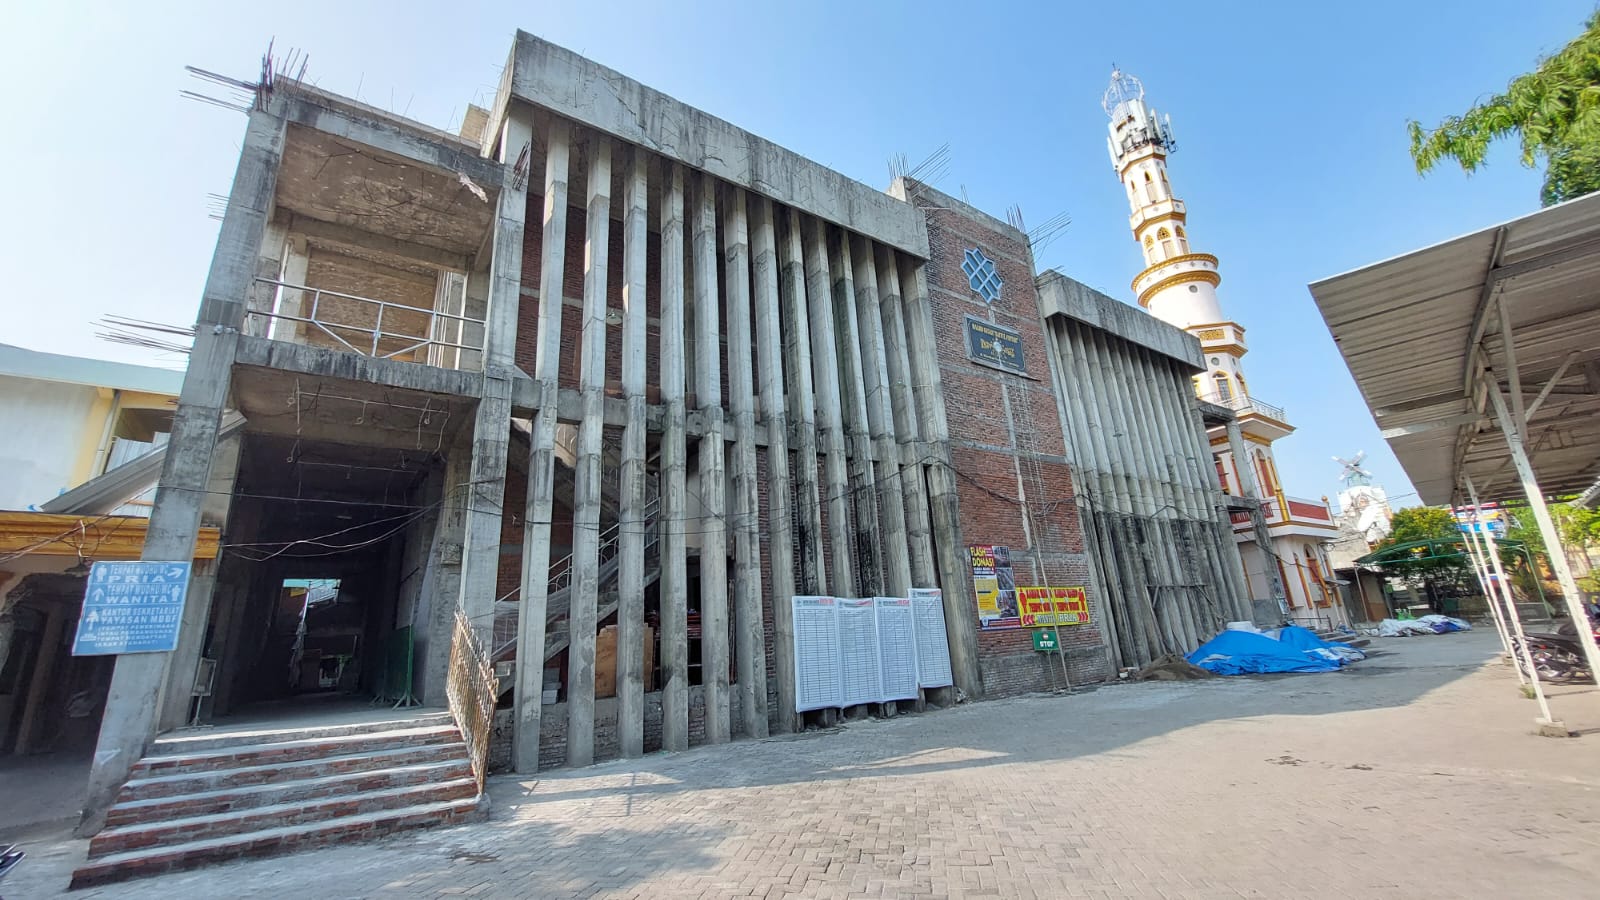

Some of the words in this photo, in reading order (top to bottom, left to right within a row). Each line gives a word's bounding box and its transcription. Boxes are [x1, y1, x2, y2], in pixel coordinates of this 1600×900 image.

[970, 546, 987, 557] FLASH
[972, 557, 995, 567] DONASI
[108, 575, 165, 583] PRIA
[107, 595, 168, 603] WANITA
[102, 607, 132, 616] KANTOR
[133, 607, 180, 616] SEKRETARIAT
[102, 615, 146, 624] YAYASAN
